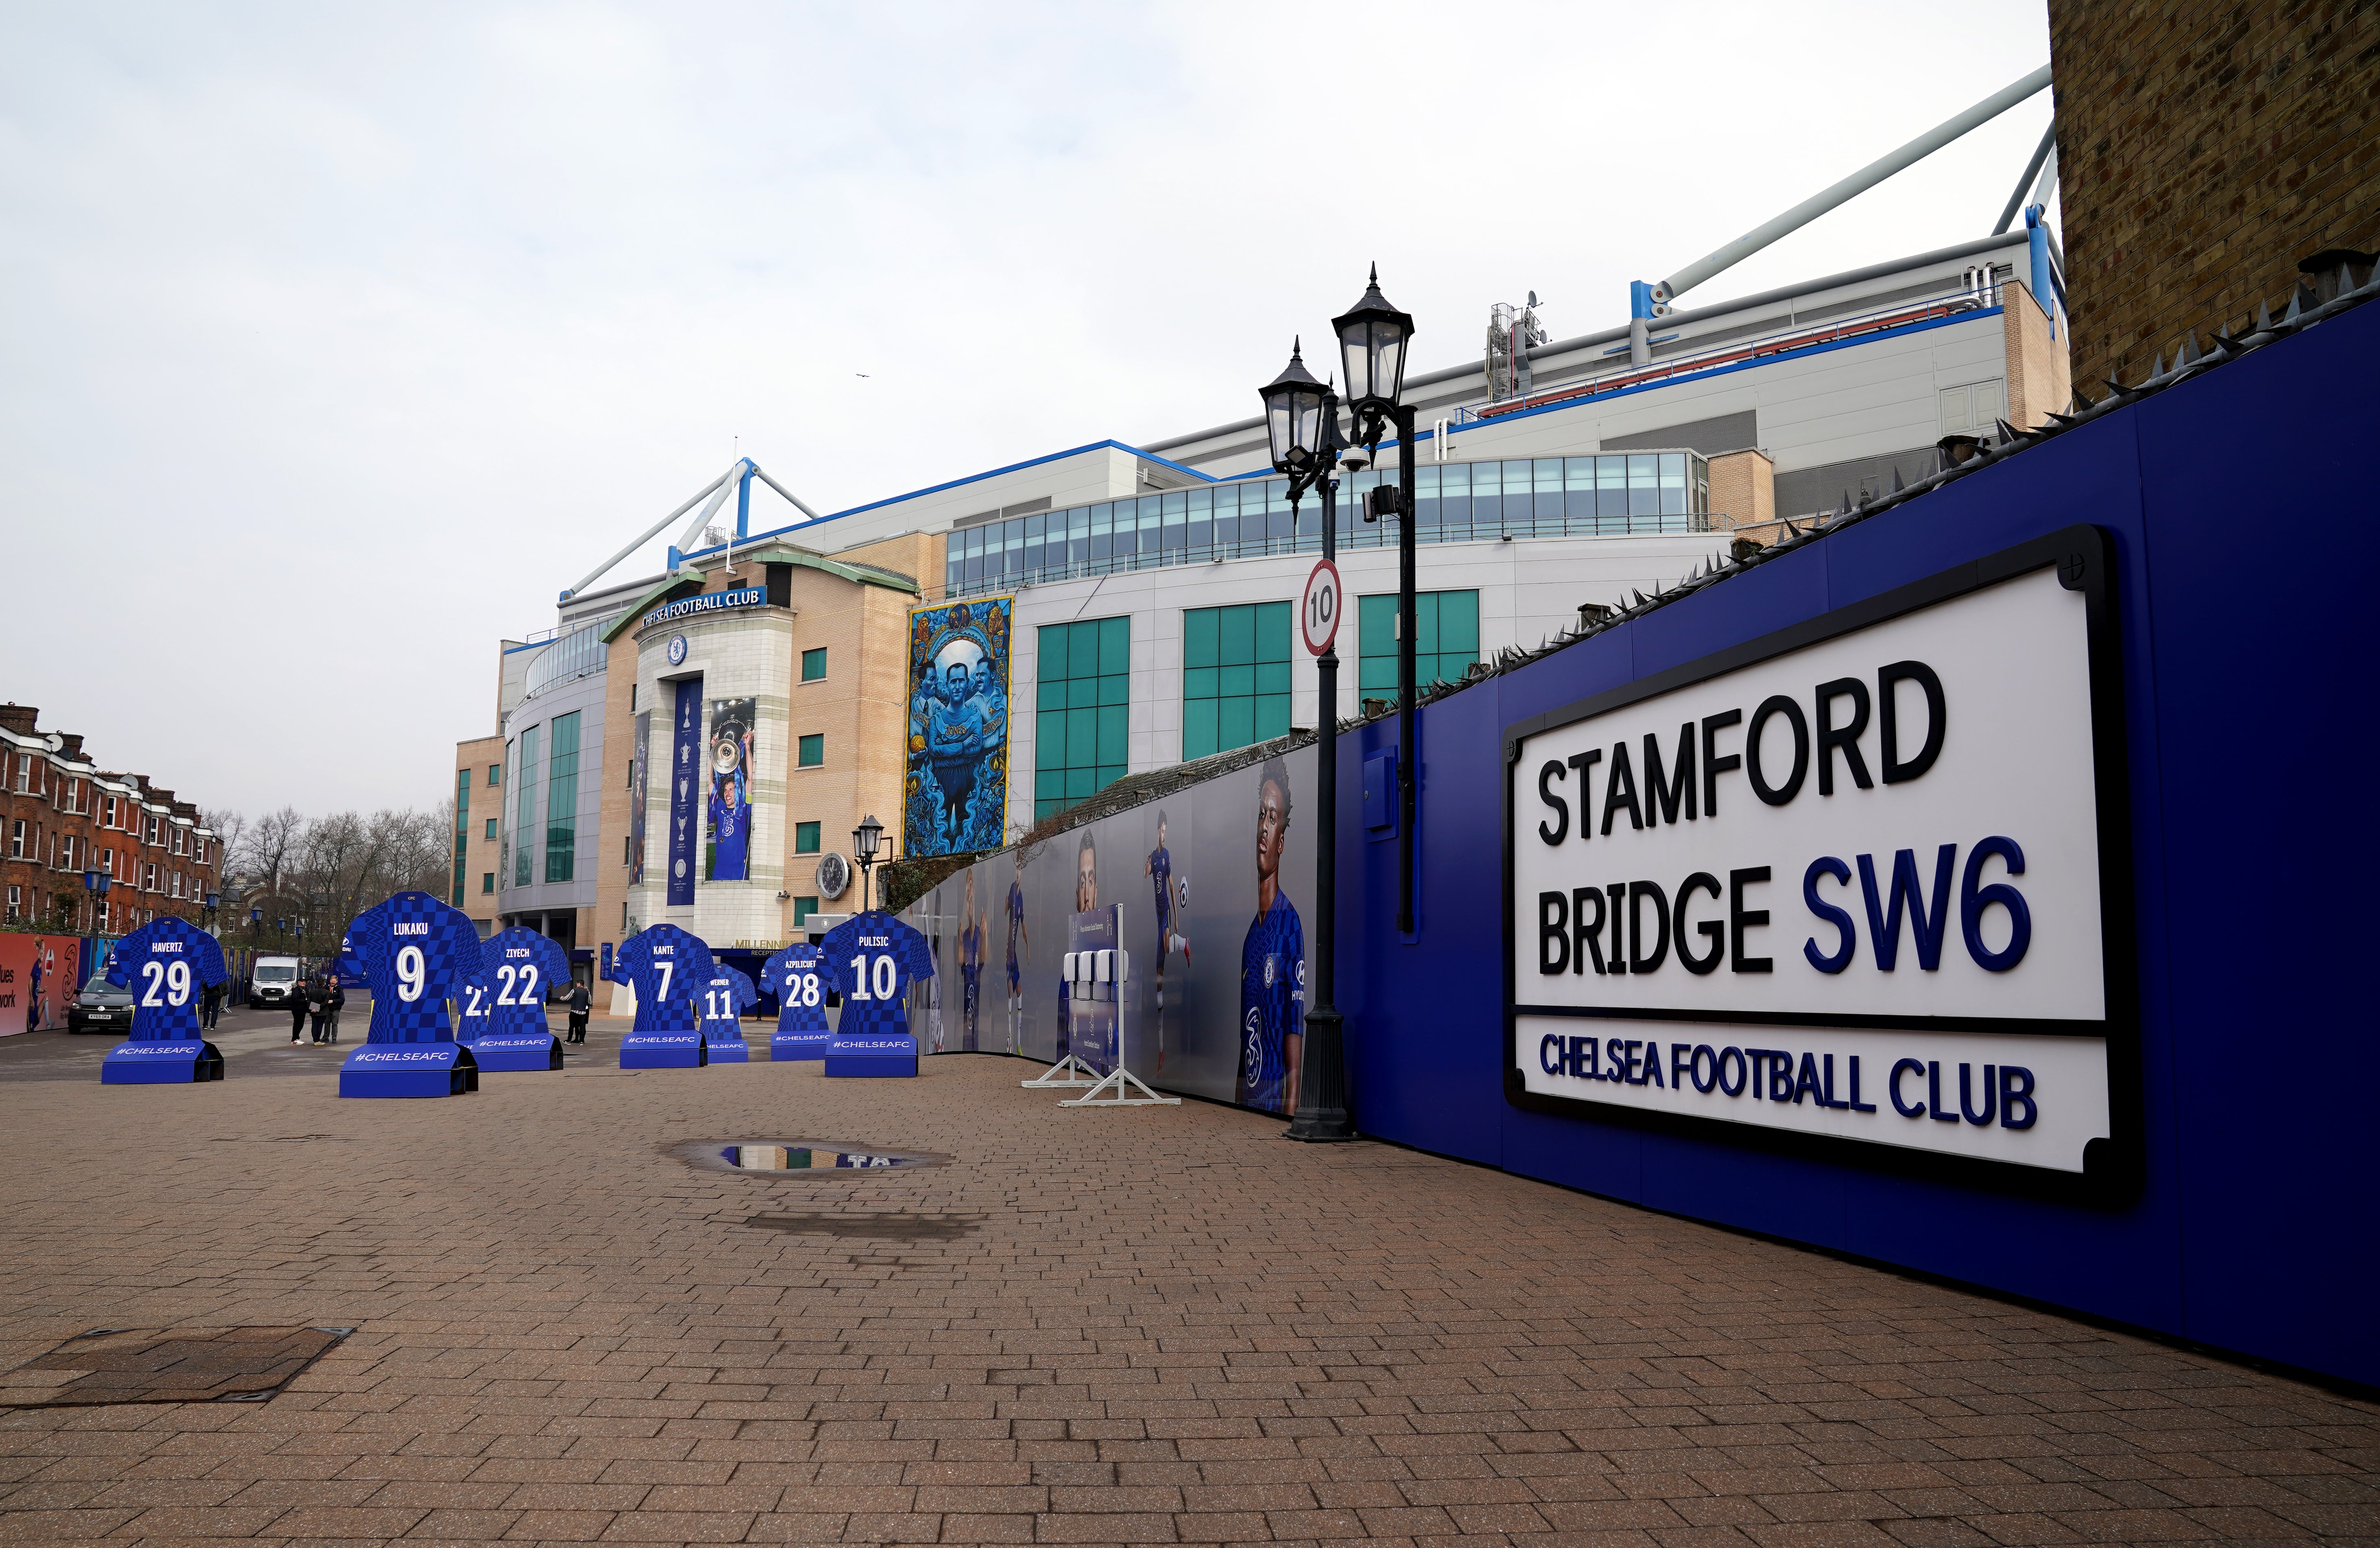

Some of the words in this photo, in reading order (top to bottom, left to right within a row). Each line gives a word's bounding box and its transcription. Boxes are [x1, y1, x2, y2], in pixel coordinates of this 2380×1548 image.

[642, 607, 669, 626] CHELSEA
[670, 596, 723, 617] FOOTBALL
[726, 590, 759, 606] CLUB
[1311, 585, 1332, 628] 10
[945, 725, 967, 735] JONES
[1539, 660, 1947, 846] STAMFORD
[1539, 865, 1773, 975] BRIDGE
[1803, 835, 2031, 974] SW6
[394, 922, 428, 935] LUKAKU
[735, 939, 802, 949] MILLENNIU
[859, 936, 889, 946] PULISIC
[152, 942, 182, 952] HAVERTZ
[506, 948, 530, 958] ZIYECH
[654, 946, 674, 954] KANTE
[396, 946, 425, 1002] 9
[785, 960, 816, 968] AZPILICUET
[851, 954, 897, 1000] 10
[142, 961, 191, 1007] 29
[497, 964, 539, 1006] 22
[654, 961, 673, 1002] 7
[785, 973, 820, 1007] 28
[705, 990, 734, 1020] 11
[355, 1052, 450, 1062] #CHELSEAFC
[479, 1039, 547, 1047] #CHELSEAFC
[1540, 1033, 1664, 1088] CHELSEA
[1671, 1043, 1876, 1113] FOOTBALL
[1889, 1057, 2037, 1130] CLUB
